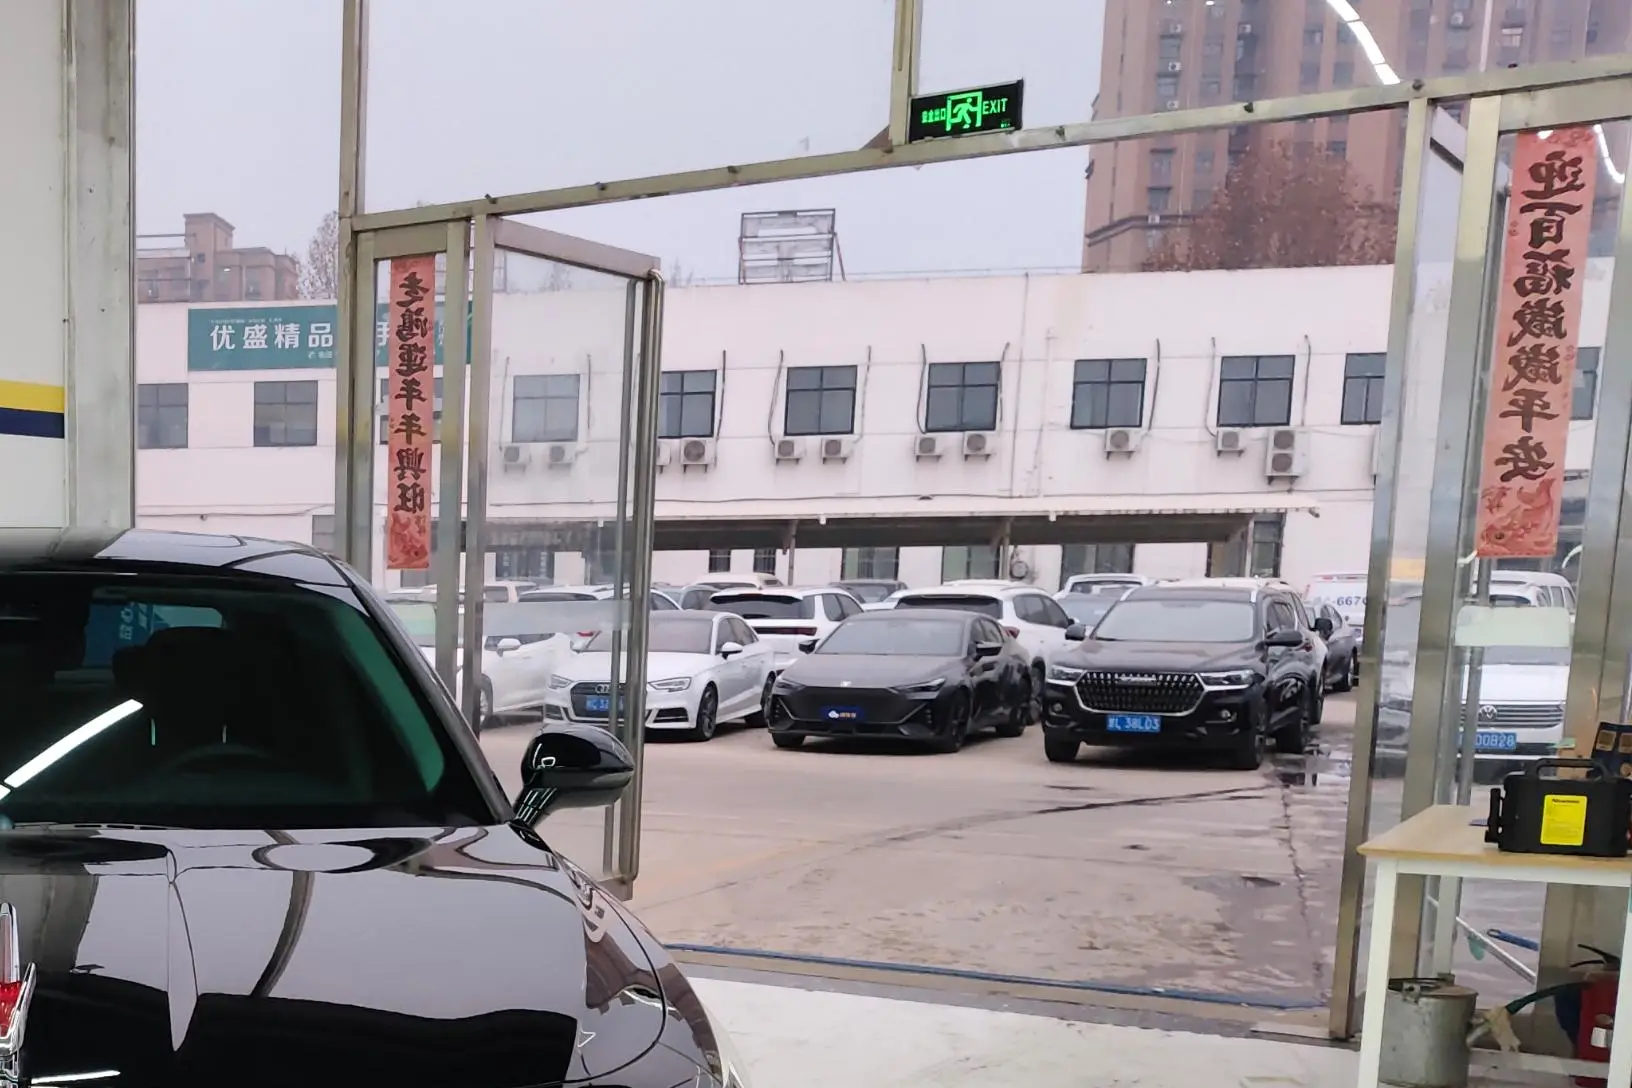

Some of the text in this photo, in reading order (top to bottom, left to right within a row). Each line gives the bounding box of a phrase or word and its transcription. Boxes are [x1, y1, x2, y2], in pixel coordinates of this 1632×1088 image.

[982, 98, 1008, 115] EXIT
[210, 322, 334, 351] 优盛精品
